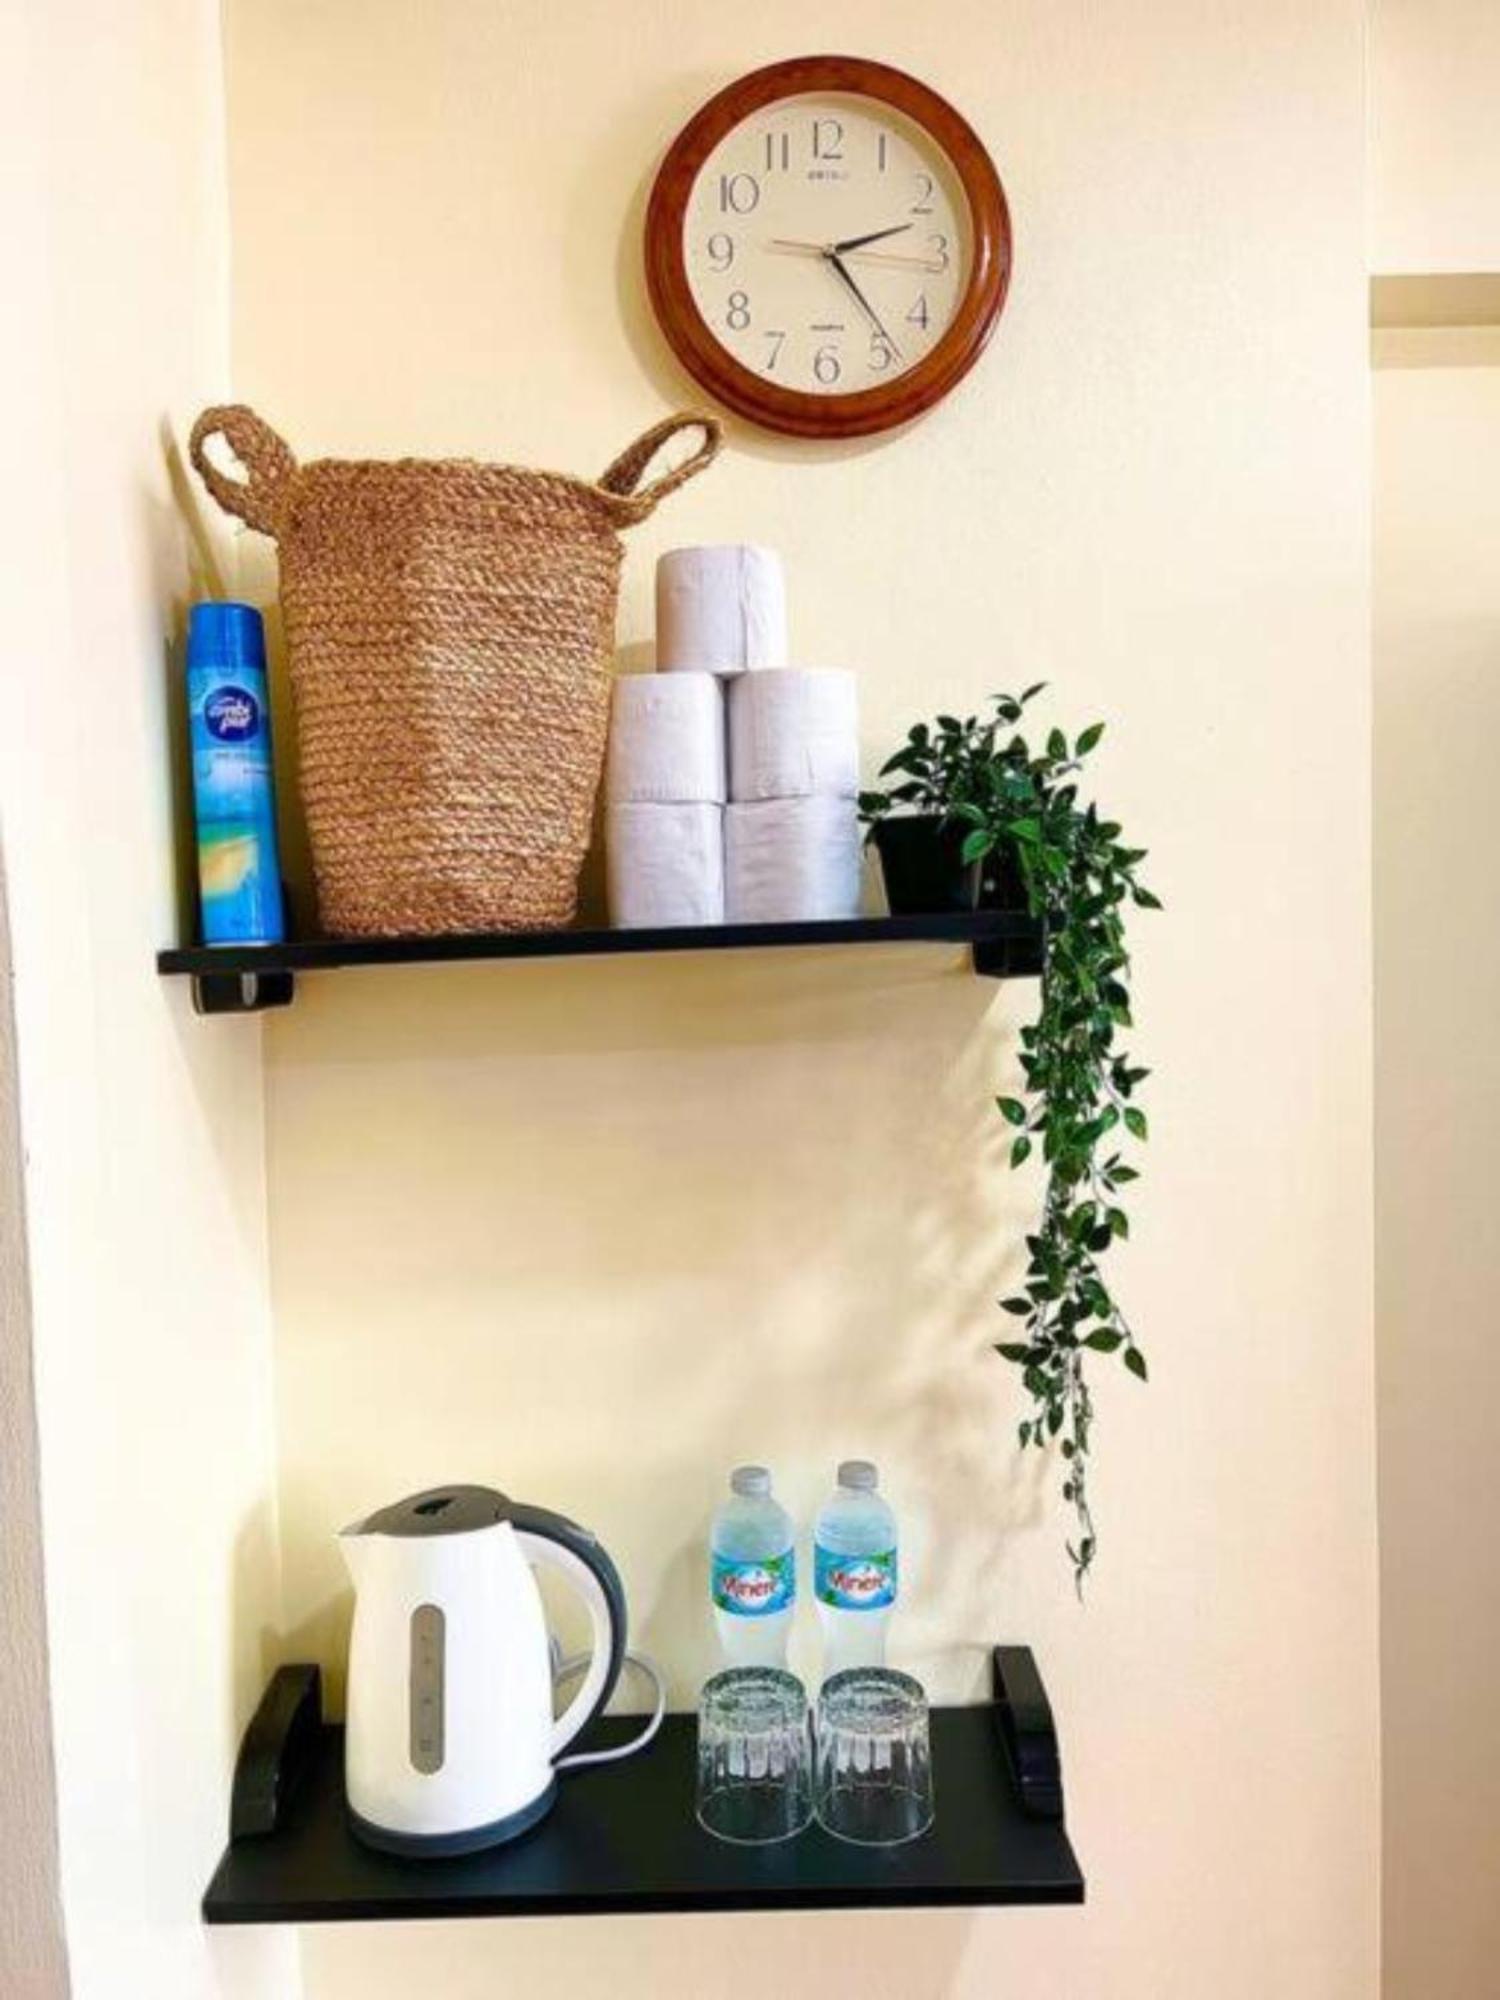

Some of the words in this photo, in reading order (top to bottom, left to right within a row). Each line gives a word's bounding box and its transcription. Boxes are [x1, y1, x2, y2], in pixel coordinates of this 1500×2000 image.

[766, 133, 789, 171] 11
[812, 119, 843, 159] 12
[877, 134, 886, 172] 1
[719, 173, 760, 214] 10
[910, 174, 934, 216] 2
[707, 233, 734, 272] 9
[927, 234, 950, 274] 3
[726, 291, 751, 331] 8
[906, 293, 931, 330] 4
[763, 332, 786, 371] 7
[813, 345, 841, 385] 6
[867, 332, 893, 372] 5
